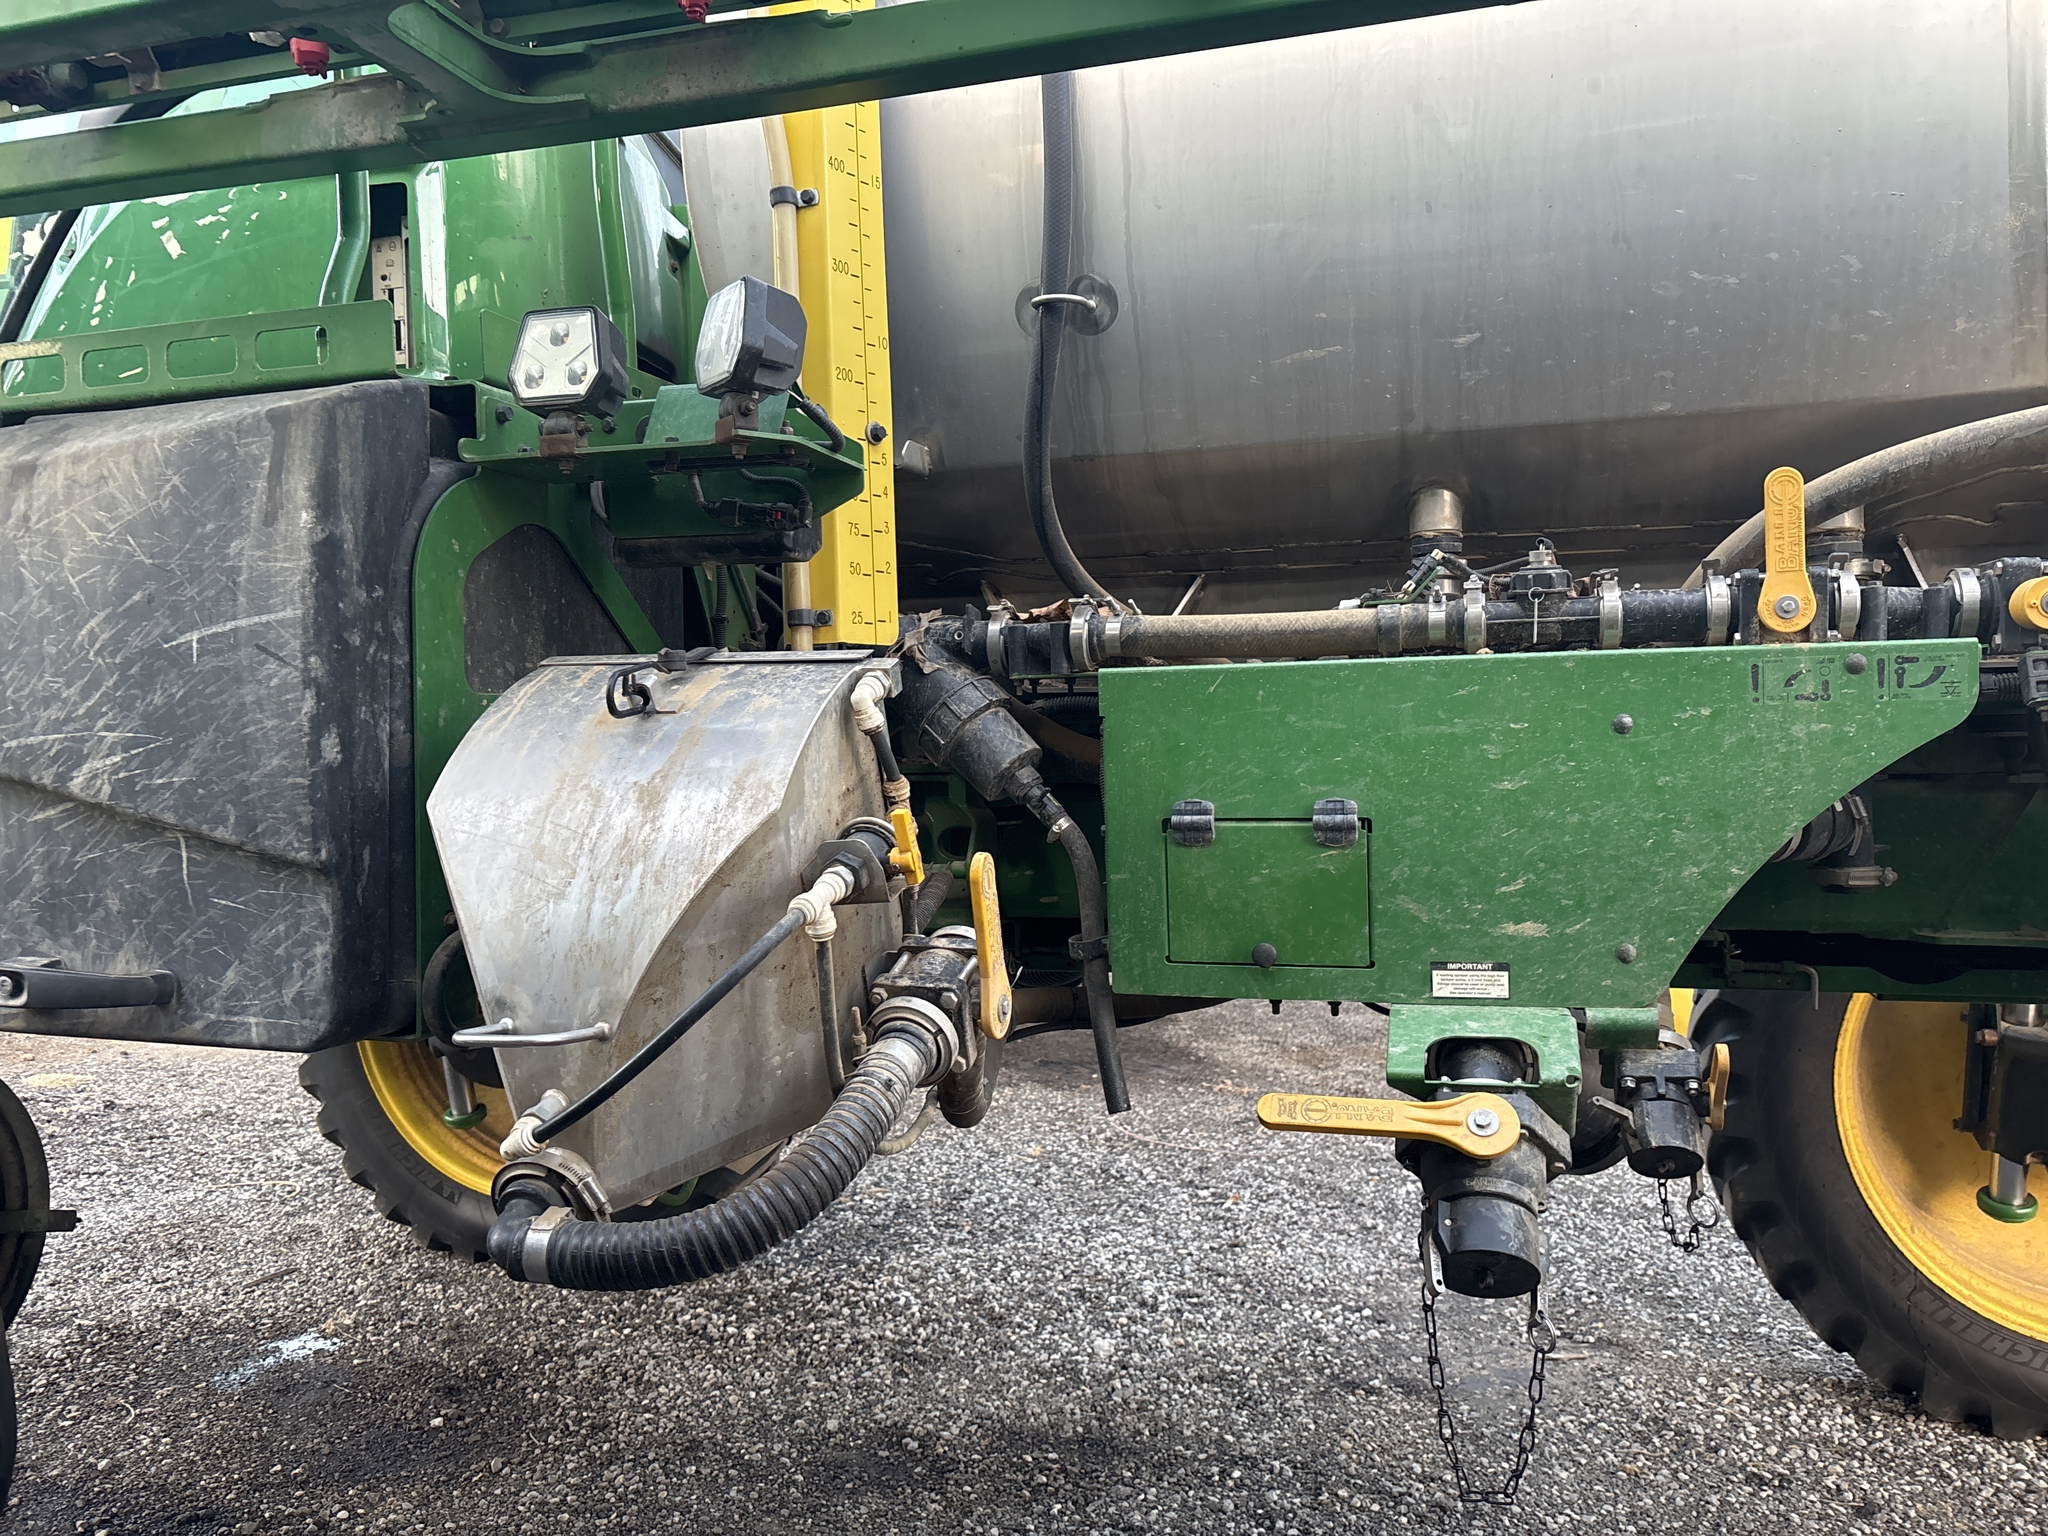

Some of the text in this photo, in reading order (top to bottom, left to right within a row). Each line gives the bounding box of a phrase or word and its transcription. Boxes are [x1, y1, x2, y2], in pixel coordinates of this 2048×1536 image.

[828, 156, 845, 174] 400
[871, 174, 881, 190] 15
[832, 258, 849, 276] 300
[877, 336, 888, 350] 10
[836, 366, 853, 383] 200
[881, 454, 888, 468] 5
[882, 486, 888, 500] 4
[848, 522, 860, 536] 75
[884, 521, 890, 534] 3
[850, 562, 861, 576] 50
[885, 562, 891, 574] 2
[852, 611, 864, 625] 25
[1909, 1289, 2048, 1373] ICHELIN
